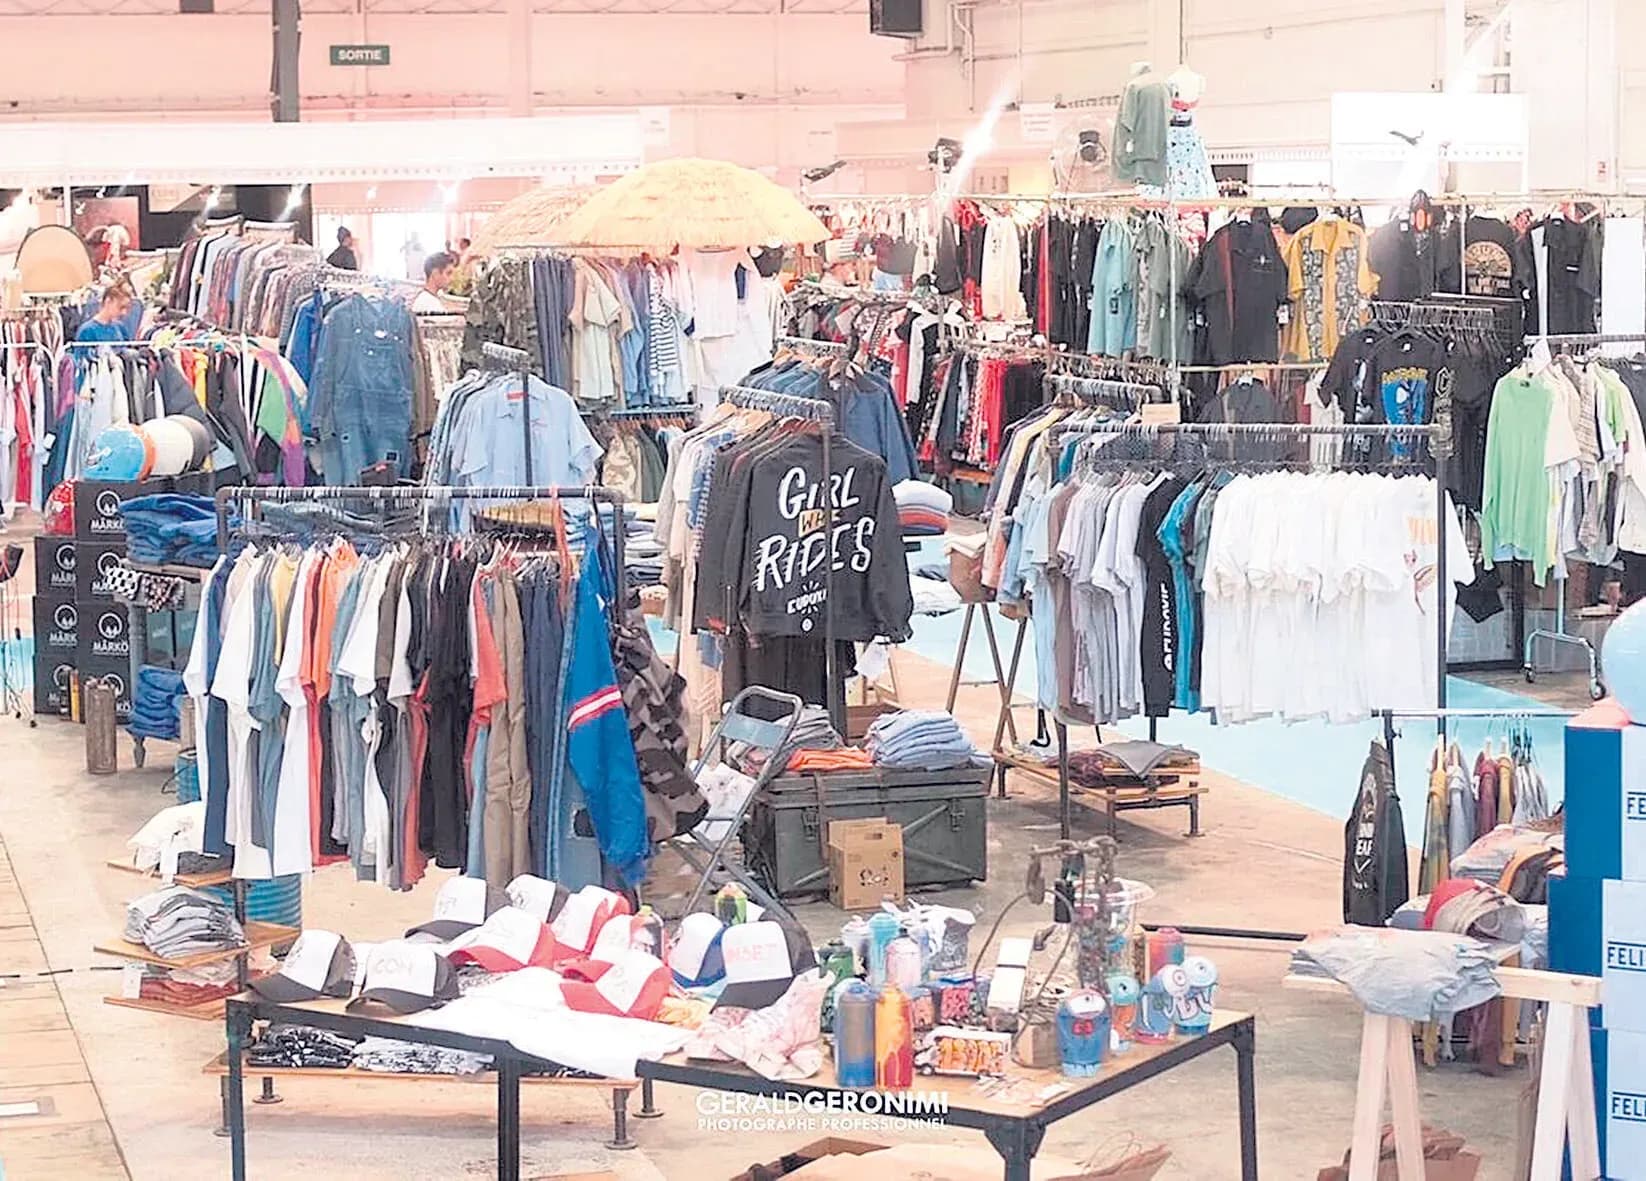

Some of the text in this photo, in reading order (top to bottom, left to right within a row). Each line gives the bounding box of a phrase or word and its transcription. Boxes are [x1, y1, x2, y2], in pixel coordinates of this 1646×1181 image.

[338, 48, 382, 61] SORTIE
[778, 466, 860, 520] GIRL
[751, 516, 876, 592] RIDES
